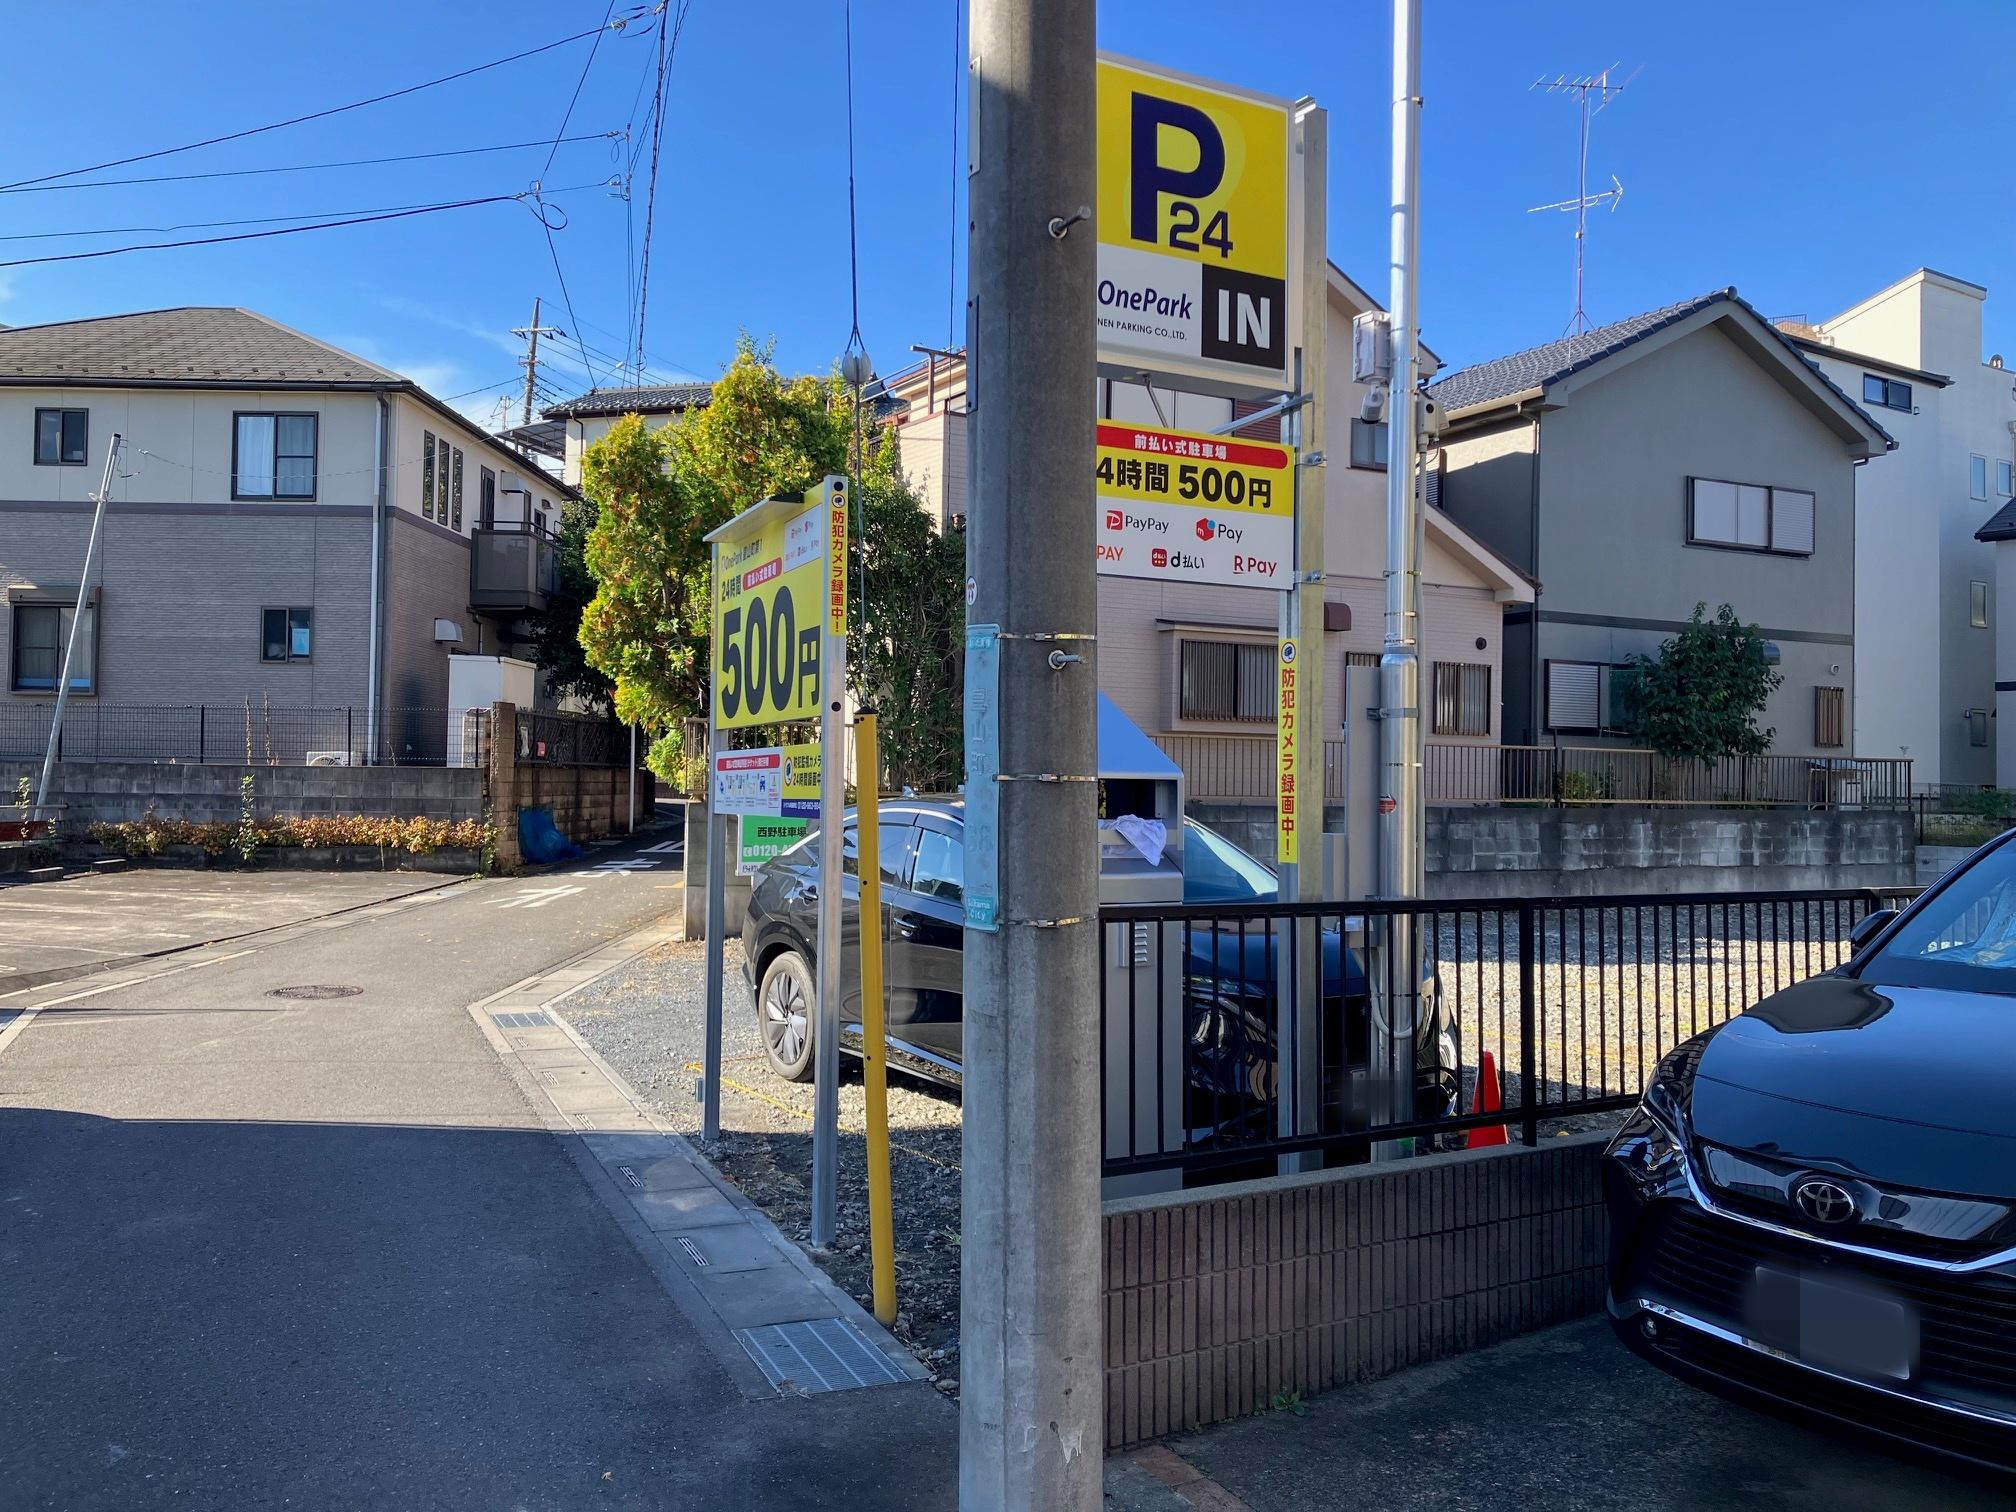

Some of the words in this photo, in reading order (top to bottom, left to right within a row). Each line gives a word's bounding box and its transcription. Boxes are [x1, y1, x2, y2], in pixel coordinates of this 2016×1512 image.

[1098, 280, 1192, 319] OnePark
[1218, 289, 1271, 350] IN
[1116, 321, 1152, 335] PARKING
[1134, 433, 1227, 460] 前払い式駐車場
[1178, 464, 1272, 509] 500円
[1125, 515, 1170, 534] PayPay
[1218, 523, 1243, 543] Pay
[1096, 545, 1124, 561] PAY
[1170, 551, 1205, 569] d払い
[831, 510, 845, 633] 防犯カメラ録画中!
[1248, 557, 1278, 577] Pay
[721, 574, 742, 602] 24時間
[721, 585, 820, 720] 500円
[1281, 668, 1295, 856] 防犯カメラ録画中!
[757, 826, 807, 838] 西野駐車場
